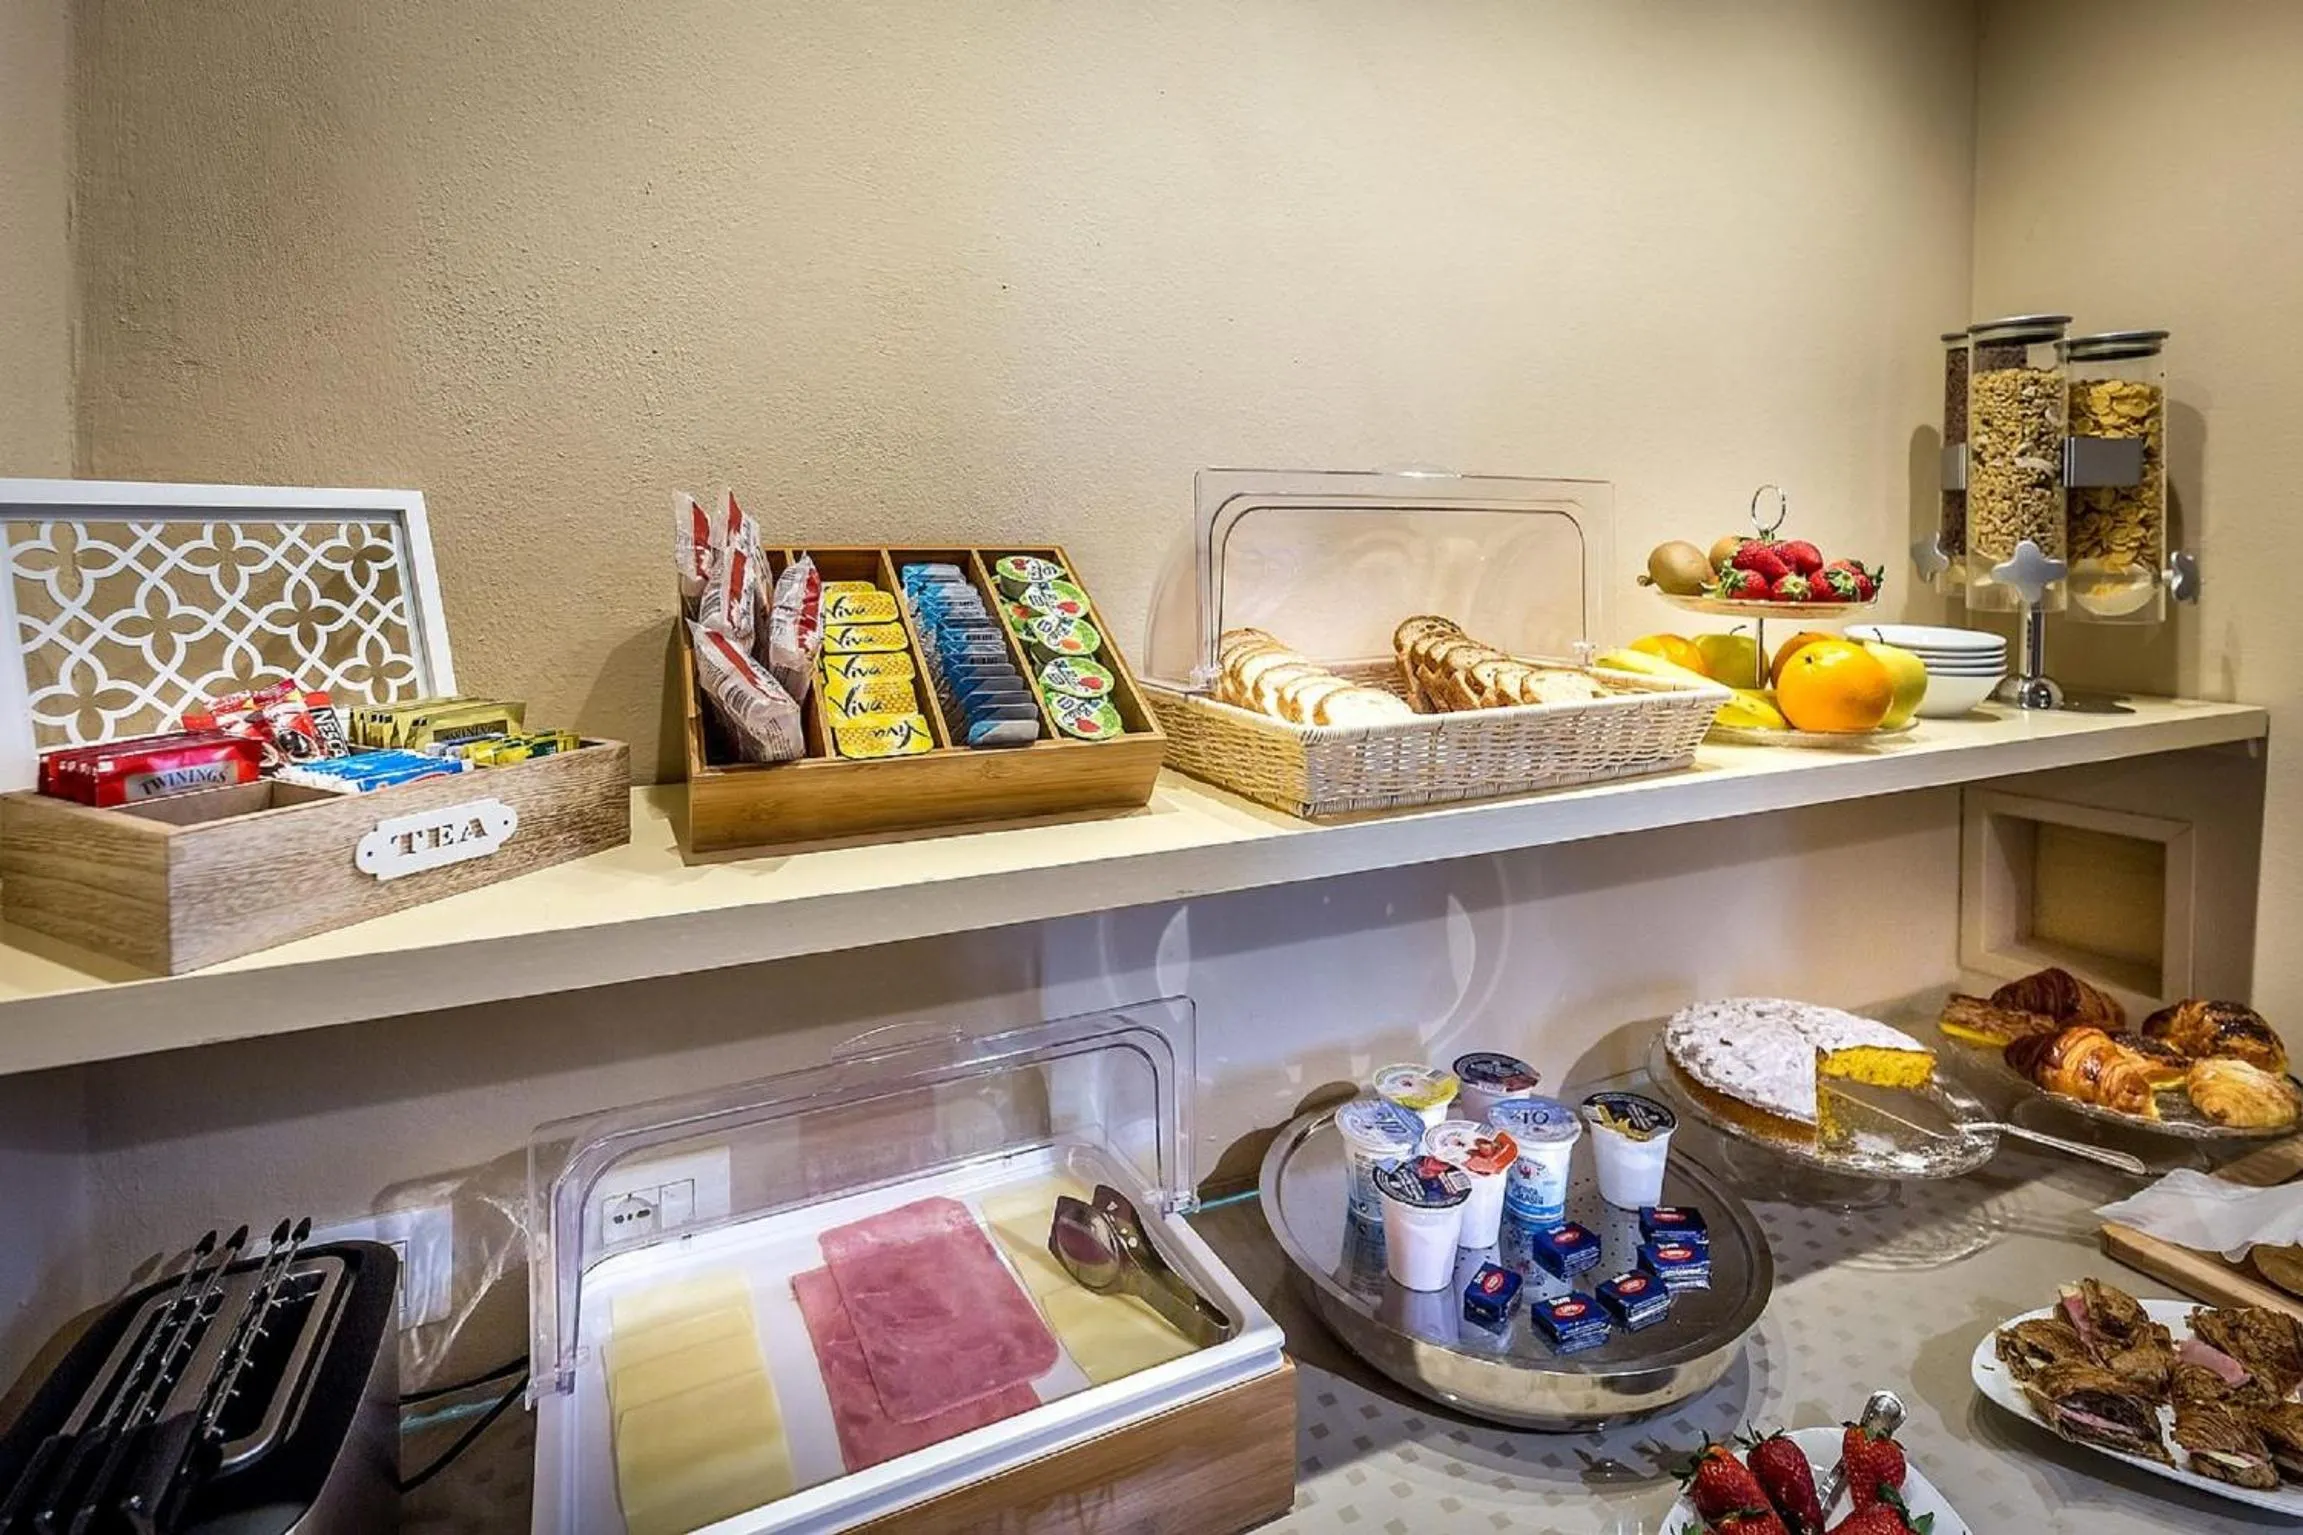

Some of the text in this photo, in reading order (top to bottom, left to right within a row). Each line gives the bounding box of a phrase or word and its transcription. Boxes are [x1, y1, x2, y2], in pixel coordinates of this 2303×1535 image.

[825, 596, 866, 619] Viva
[826, 628, 873, 648] Viva
[828, 655, 881, 679] Viva
[828, 685, 883, 718] Viva
[874, 720, 929, 748] Viva
[140, 767, 227, 795] TWININGS
[390, 818, 487, 855] TEA
